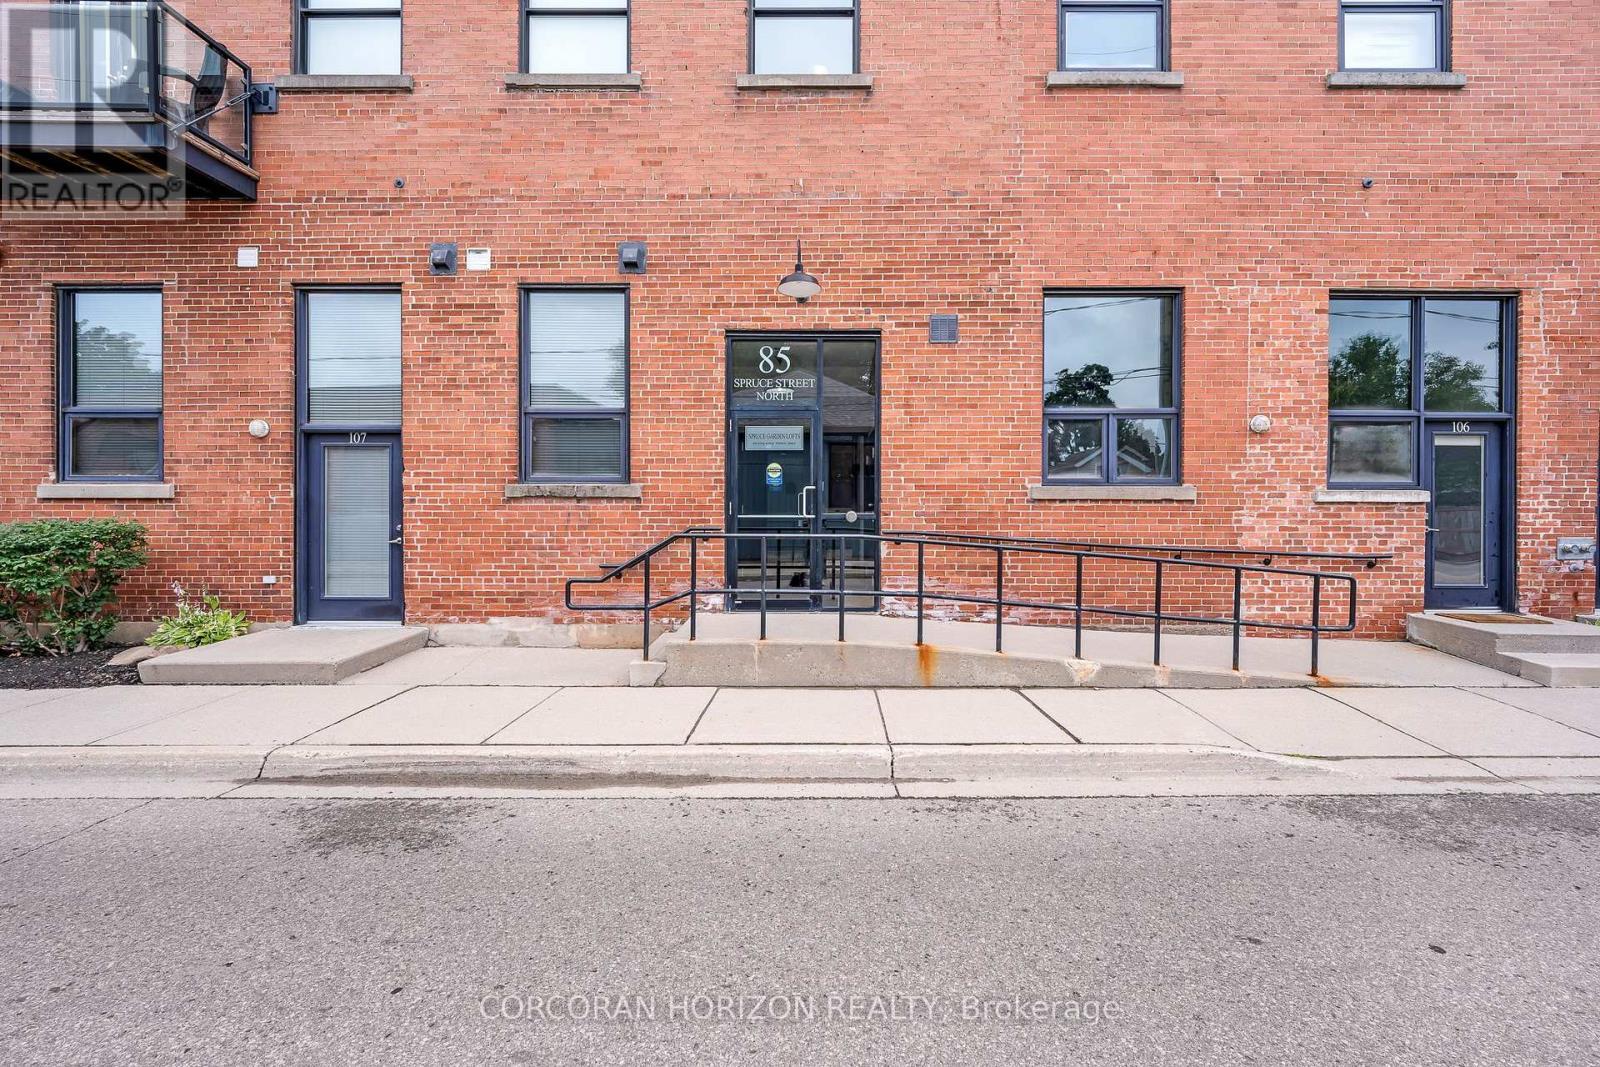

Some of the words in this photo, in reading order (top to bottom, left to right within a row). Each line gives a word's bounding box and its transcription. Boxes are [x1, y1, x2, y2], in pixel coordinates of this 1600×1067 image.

[758, 345, 791, 374] 85
[733, 378, 774, 388] SPRUCE
[775, 378, 816, 388] STREET
[756, 391, 794, 401] NORTH
[1452, 421, 1470, 433] 106
[349, 432, 367, 444] 107
